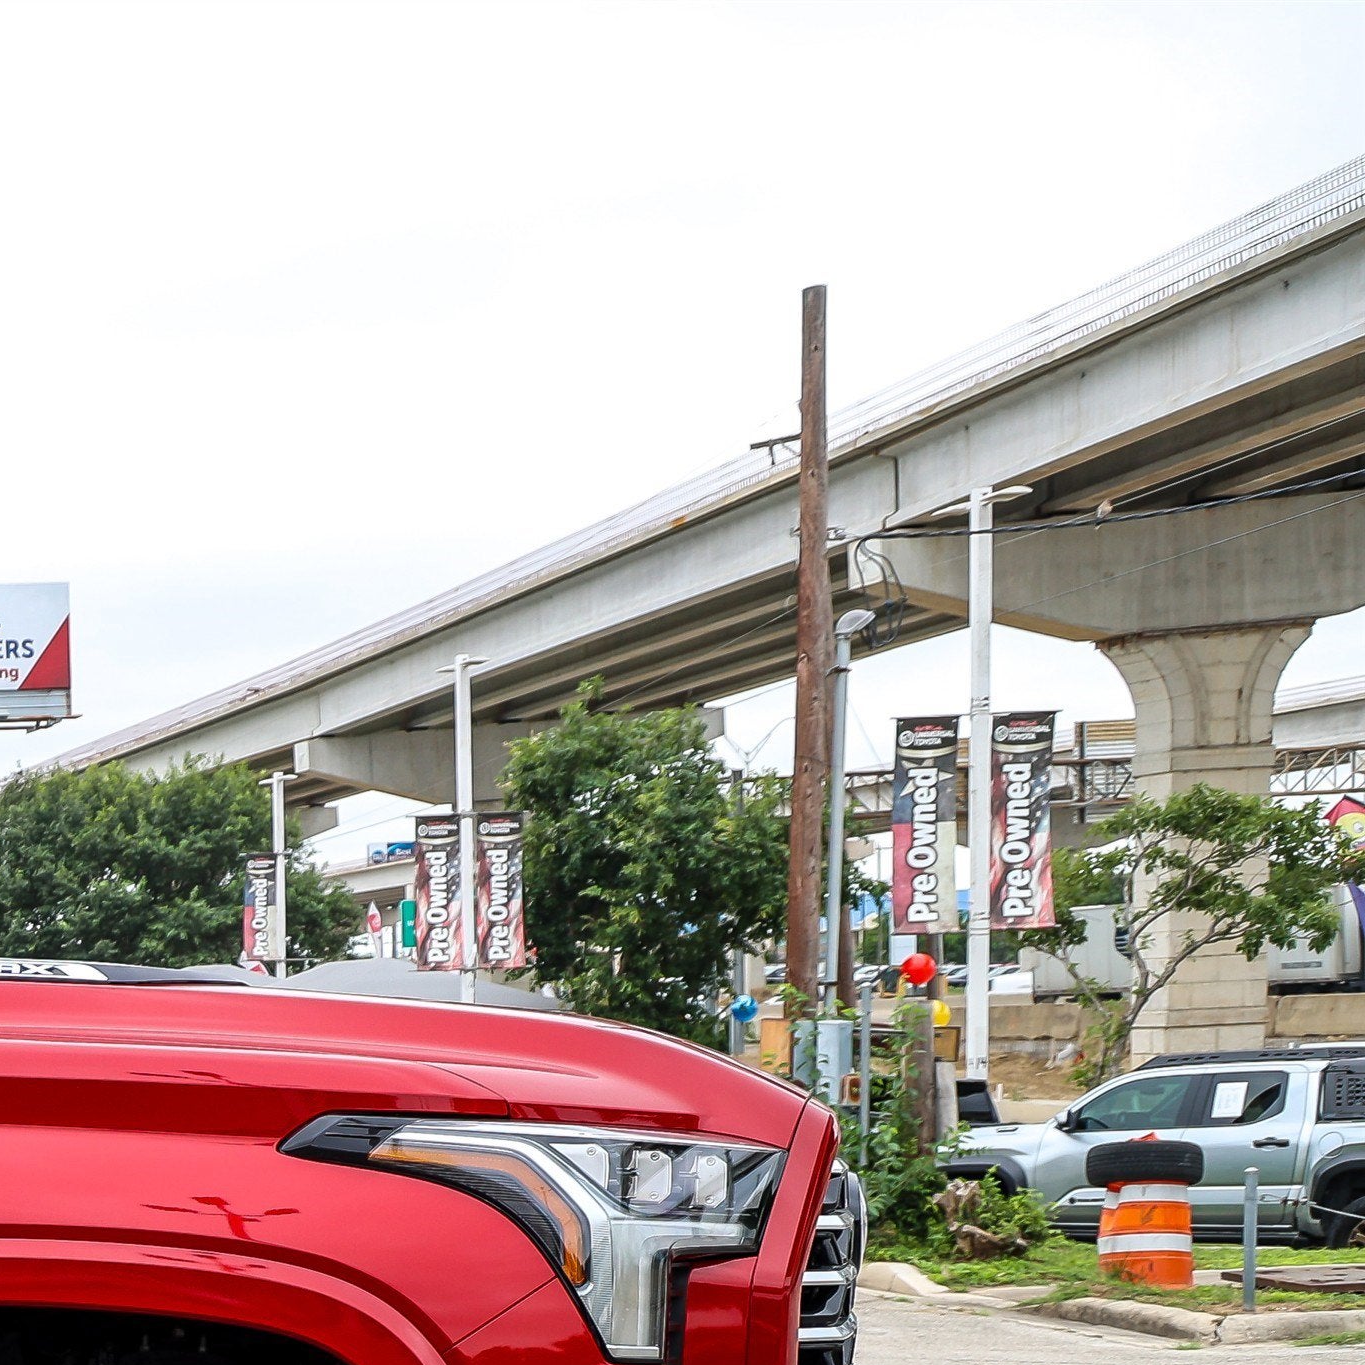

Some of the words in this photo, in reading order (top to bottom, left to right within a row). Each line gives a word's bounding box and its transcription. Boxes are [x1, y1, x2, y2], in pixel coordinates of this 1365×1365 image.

[905, 767, 939, 870] Owned
[999, 762, 1032, 865] Owned
[425, 851, 448, 924] Owned
[485, 849, 509, 923] Owned
[907, 871, 940, 923] Pre
[1002, 866, 1034, 918] Pre
[427, 925, 450, 963] Pre
[487, 923, 511, 961] Pre
